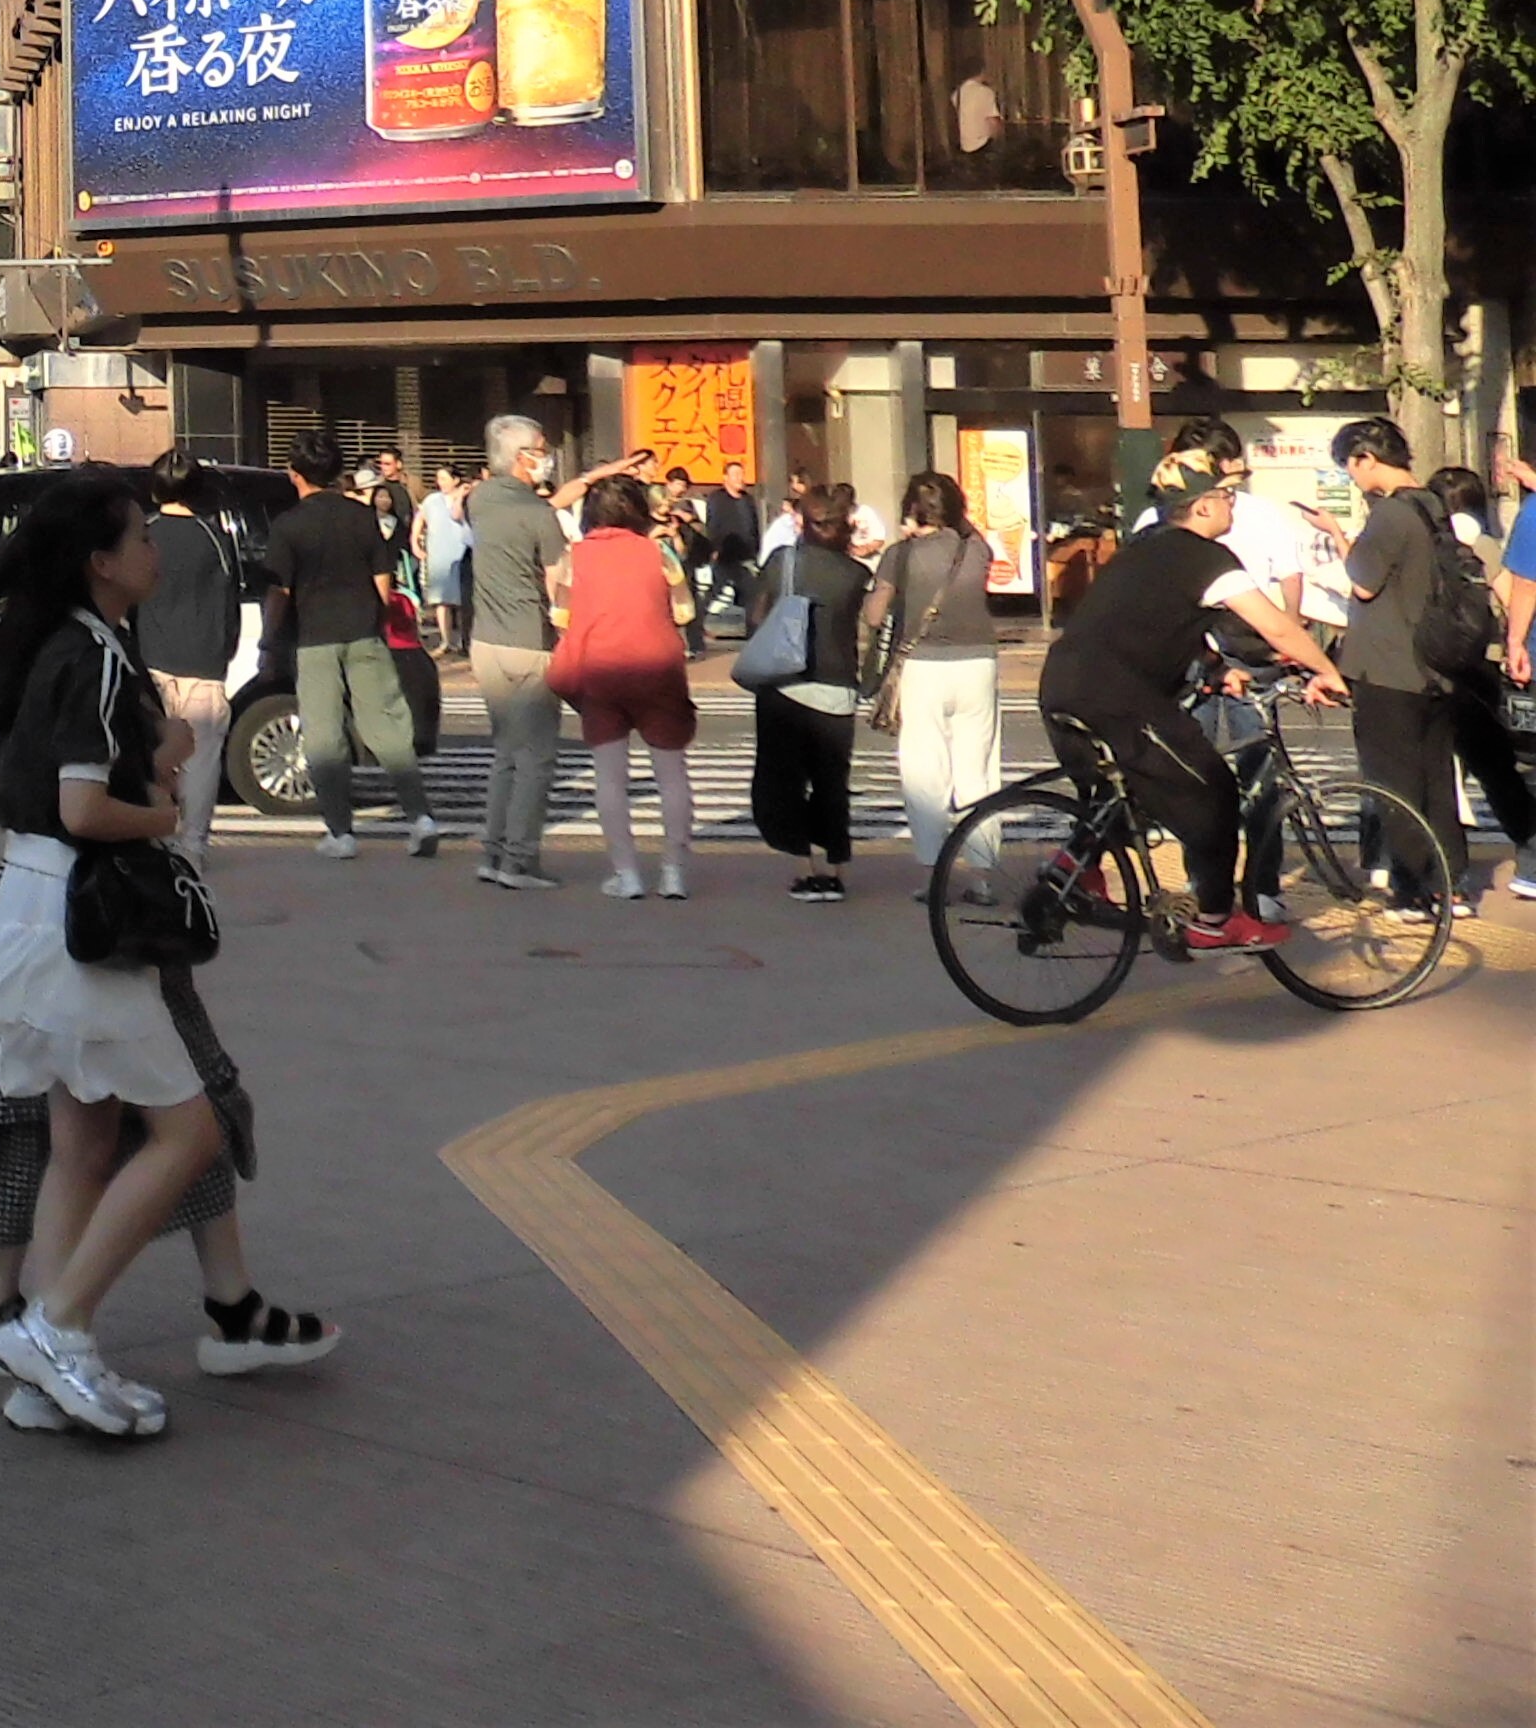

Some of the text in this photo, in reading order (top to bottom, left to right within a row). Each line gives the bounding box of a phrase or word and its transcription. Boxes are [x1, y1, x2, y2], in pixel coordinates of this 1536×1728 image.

[125, 13, 301, 96] 香る夜
[114, 103, 313, 133] ENJOY A RELAXING NIGHT
[164, 248, 439, 304] SUSUKINO
